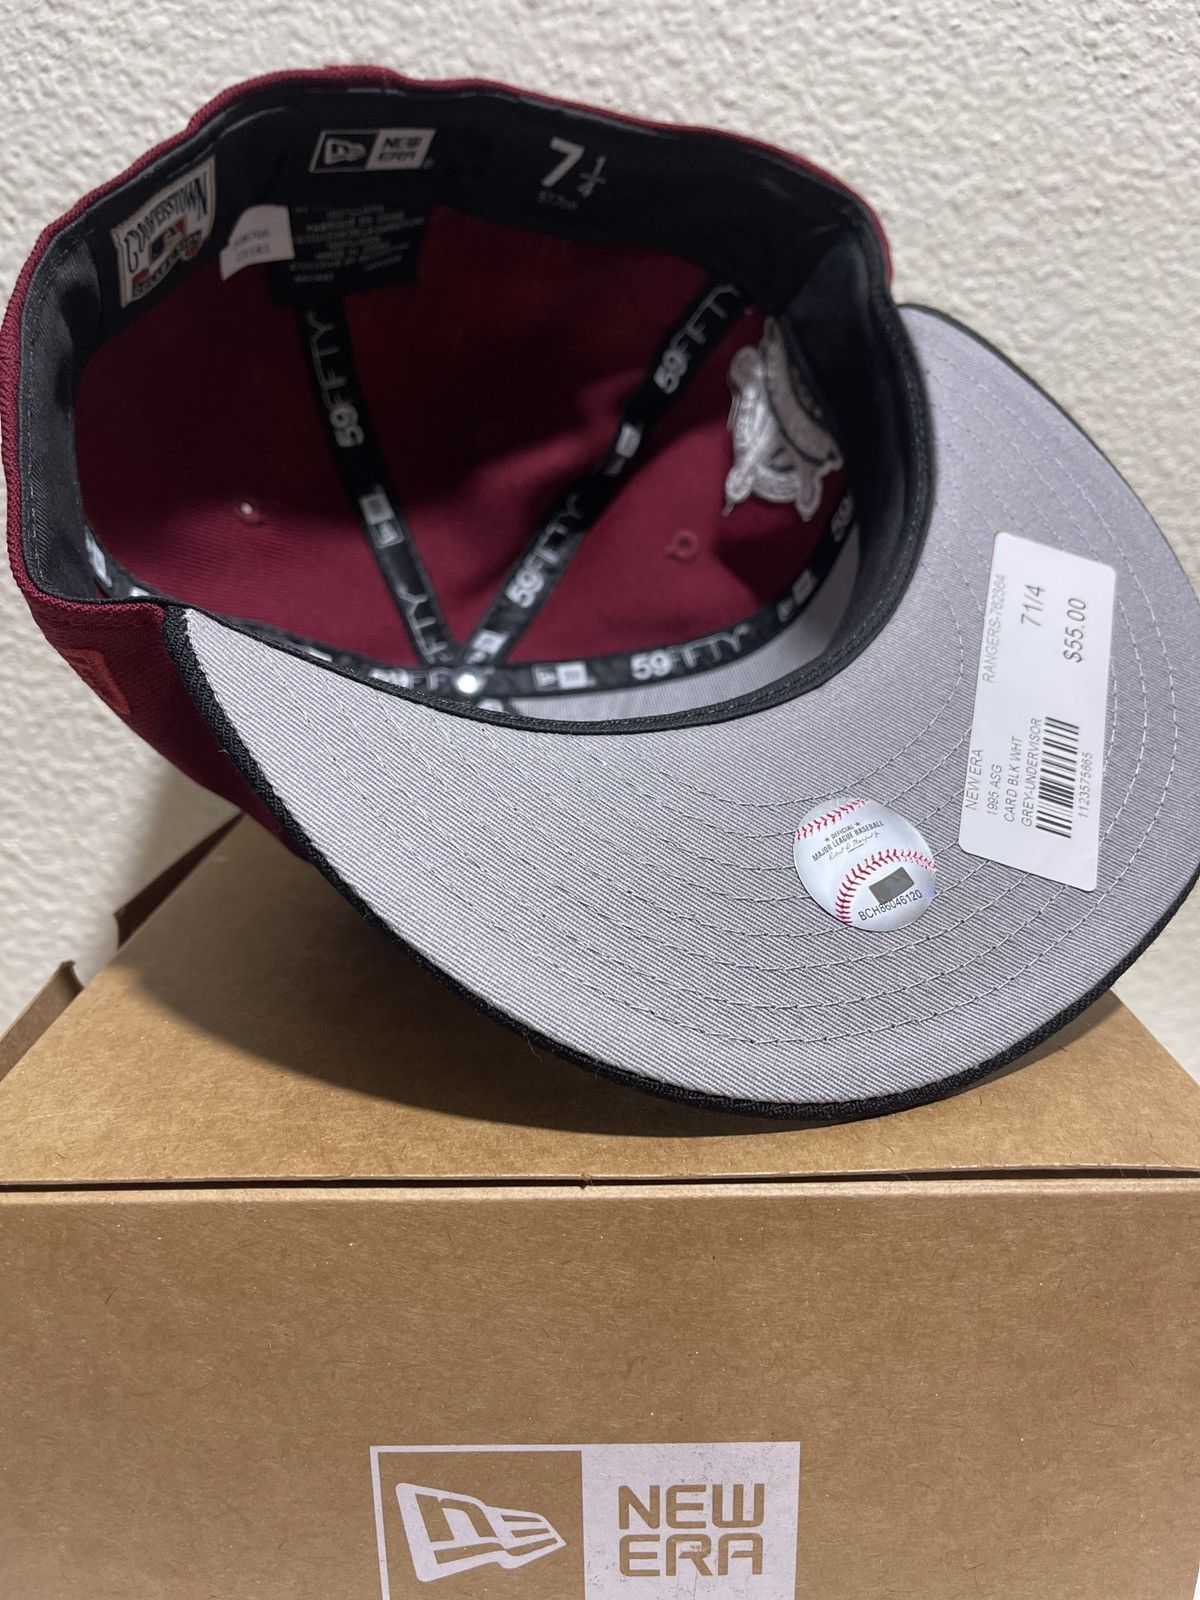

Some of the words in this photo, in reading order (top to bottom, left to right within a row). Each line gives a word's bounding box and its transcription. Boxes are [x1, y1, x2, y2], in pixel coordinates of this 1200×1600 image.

[1062, 597, 1087, 664] $55.00
[967, 749, 984, 776] ERA
[1008, 735, 1024, 762] WHT
[988, 763, 1003, 789] ASG
[1006, 762, 1021, 787] BLK
[1021, 717, 1042, 828] GREY-UNDERVISOR
[965, 777, 982, 811] NEW
[986, 791, 1001, 817] 1995
[1003, 788, 1019, 823] CARD
[811, 842, 833, 862] MAJOR
[833, 832, 855, 848] LEAGUE
[854, 820, 885, 837] BASEBALL
[831, 824, 854, 840] OFFICIAL
[618, 1483, 765, 1530] NEW
[619, 1531, 764, 1577] ERA
